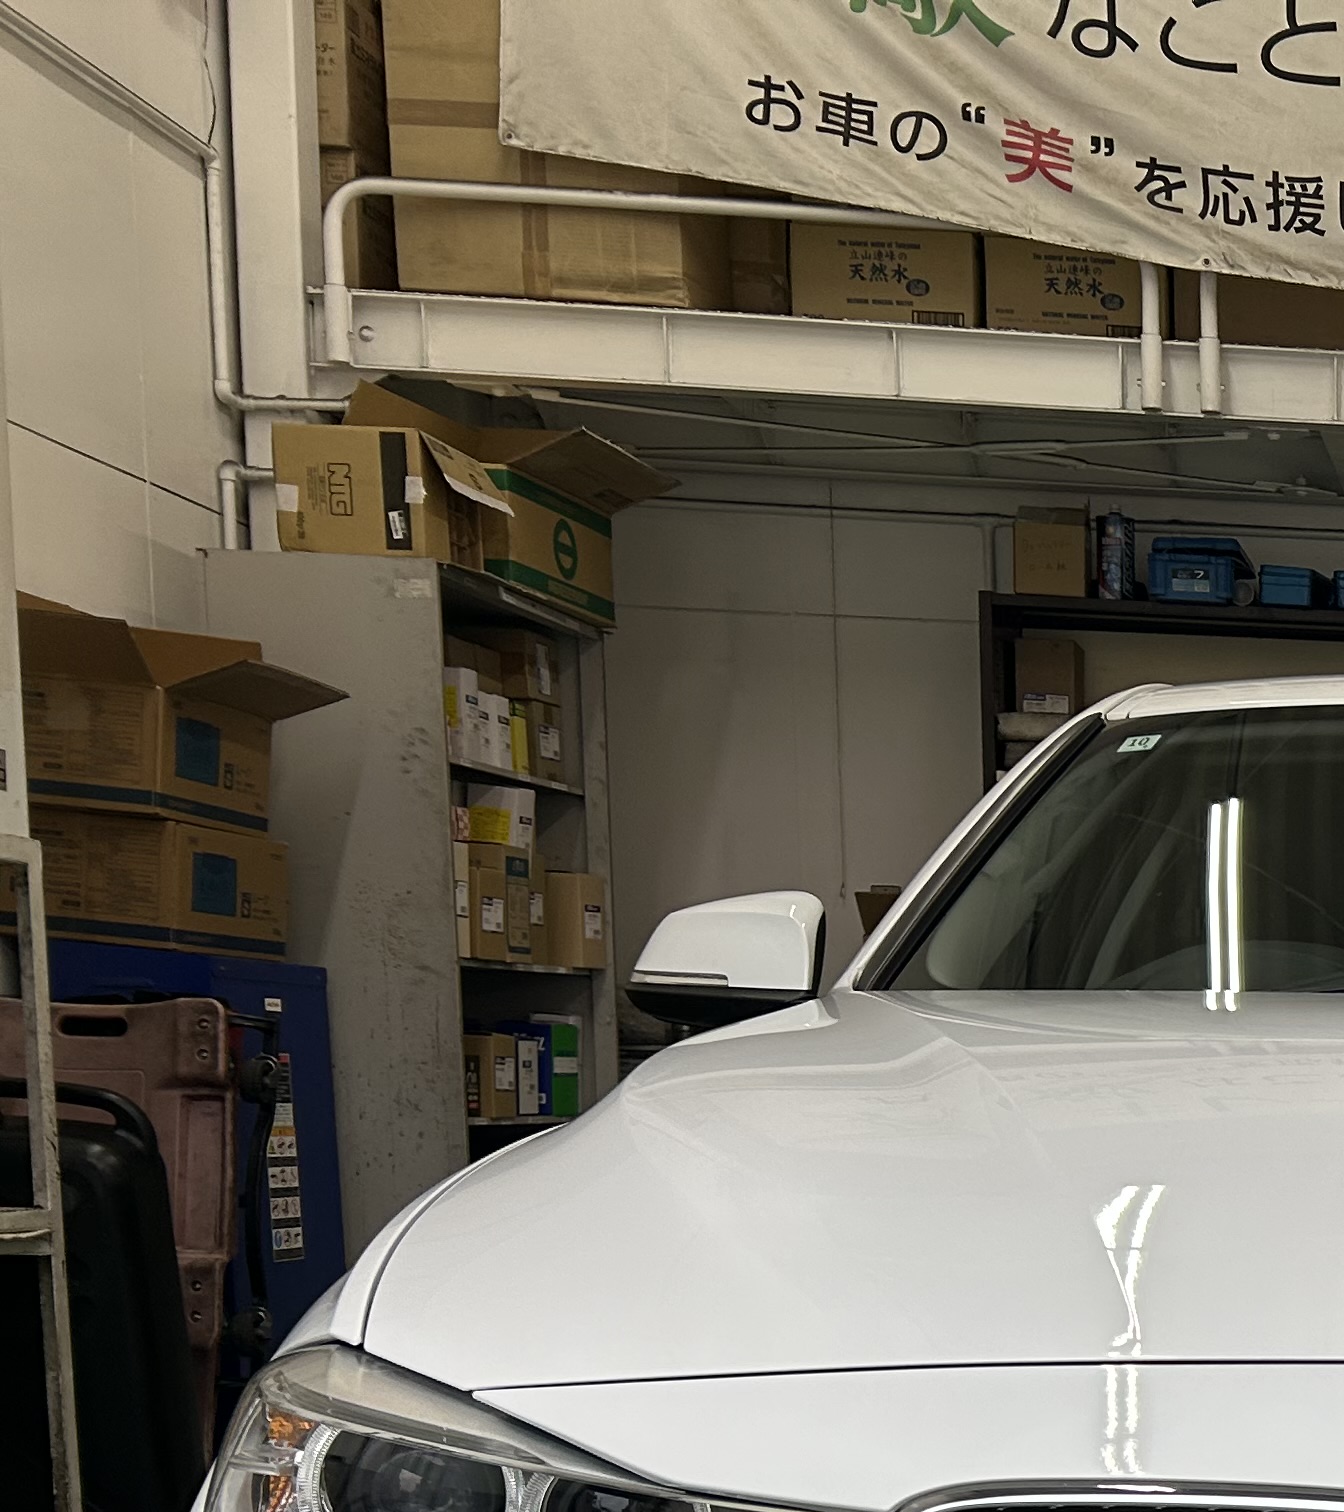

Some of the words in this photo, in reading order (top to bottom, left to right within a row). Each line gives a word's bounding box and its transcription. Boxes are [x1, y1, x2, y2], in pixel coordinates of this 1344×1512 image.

[849, 263, 909, 283] 天然水
[1045, 277, 1104, 297] 天然水
[1127, 737, 1149, 748] 10
